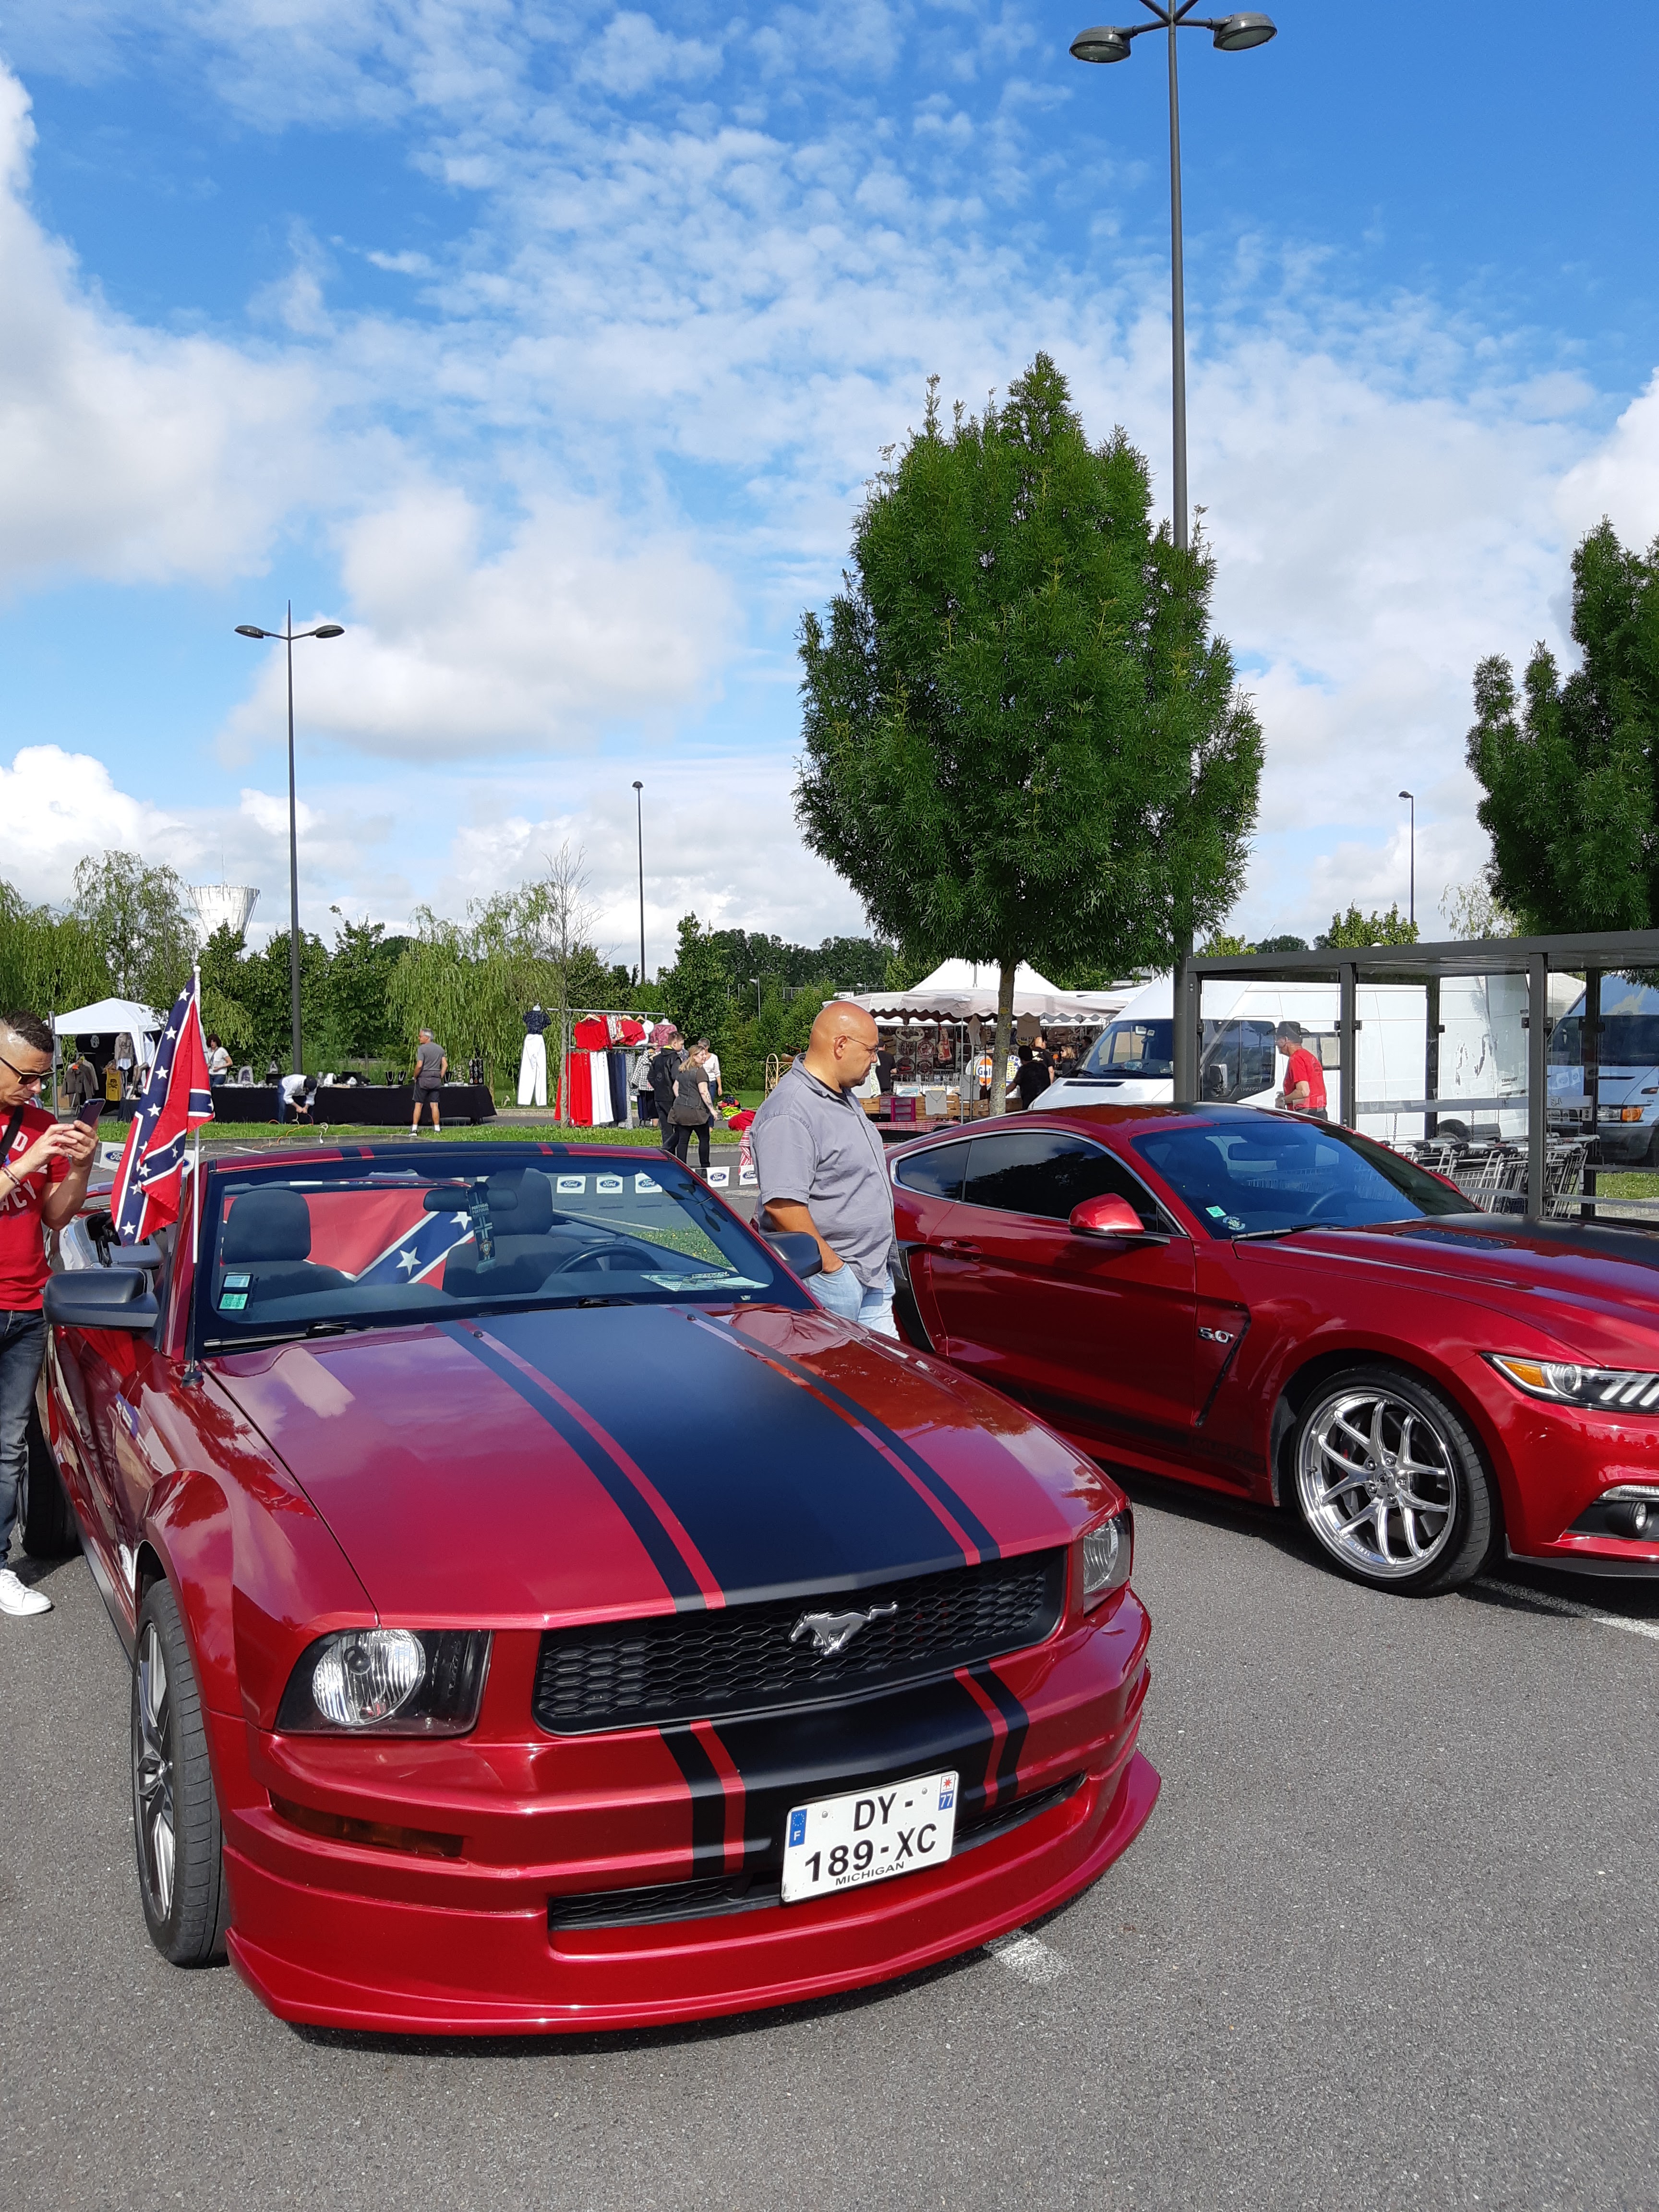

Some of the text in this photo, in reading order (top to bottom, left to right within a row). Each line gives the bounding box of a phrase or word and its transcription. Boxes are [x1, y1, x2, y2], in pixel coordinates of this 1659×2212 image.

[940, 1793, 953, 1808] 77
[793, 1830, 801, 1841] F
[805, 1823, 937, 1883] 189-XC
[835, 1861, 904, 1886] MICHIGAN
